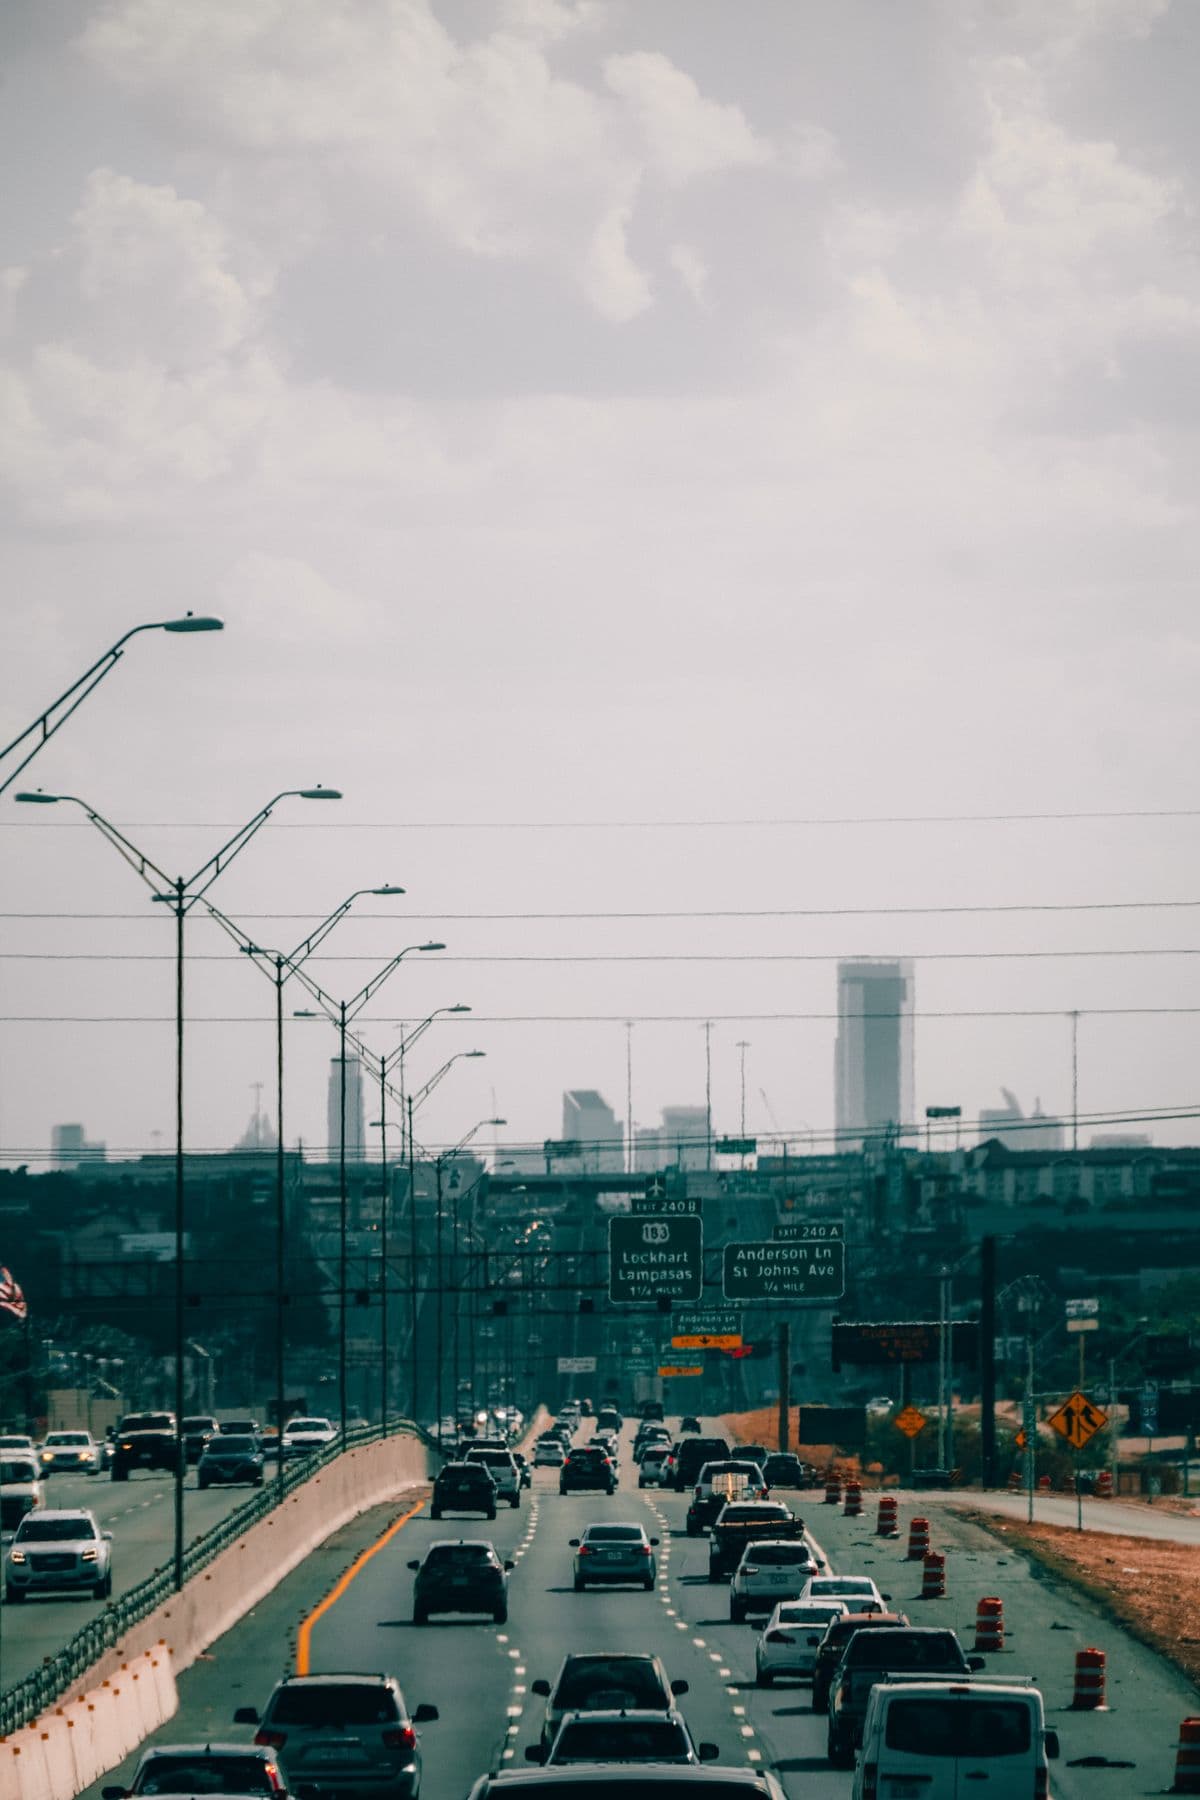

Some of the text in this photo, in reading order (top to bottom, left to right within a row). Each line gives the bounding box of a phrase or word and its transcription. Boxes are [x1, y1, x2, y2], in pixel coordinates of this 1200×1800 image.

[645, 1226, 667, 1239] 183
[778, 1227, 797, 1236] EXIT
[623, 1251, 689, 1264] Lockhart
[736, 1247, 832, 1261] Anderson Ln
[618, 1268, 693, 1283] Lampasas
[733, 1264, 834, 1277] St Johns Ave
[656, 1286, 683, 1295] MILES
[783, 1282, 805, 1291] MILE
[1143, 1407, 1157, 1417] 35
